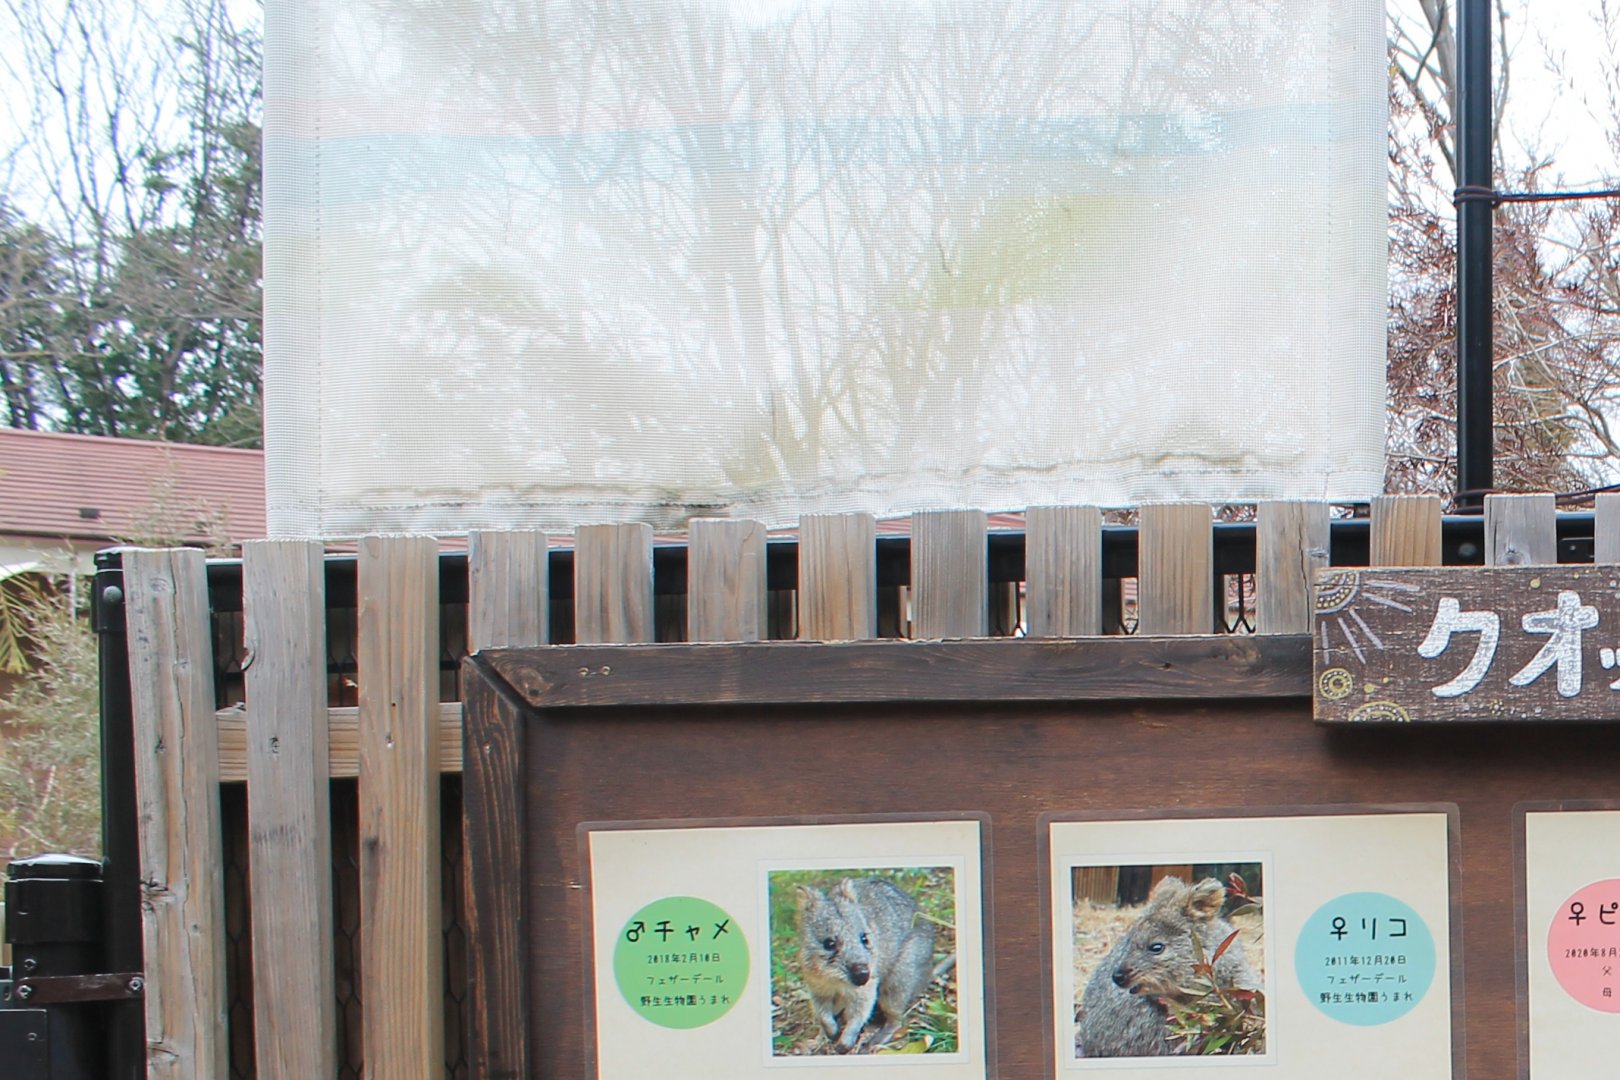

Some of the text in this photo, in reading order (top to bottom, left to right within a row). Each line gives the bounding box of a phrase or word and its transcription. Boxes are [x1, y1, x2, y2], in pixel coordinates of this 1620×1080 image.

[654, 919, 729, 942] チャメ
[1361, 917, 1406, 940] リコ
[646, 973, 724, 985] フェザーデール
[1327, 973, 1407, 984] フェザーデール
[640, 994, 730, 1007] 野生生物園うまれ
[1320, 991, 1413, 1003] 野生生物園うまれ
